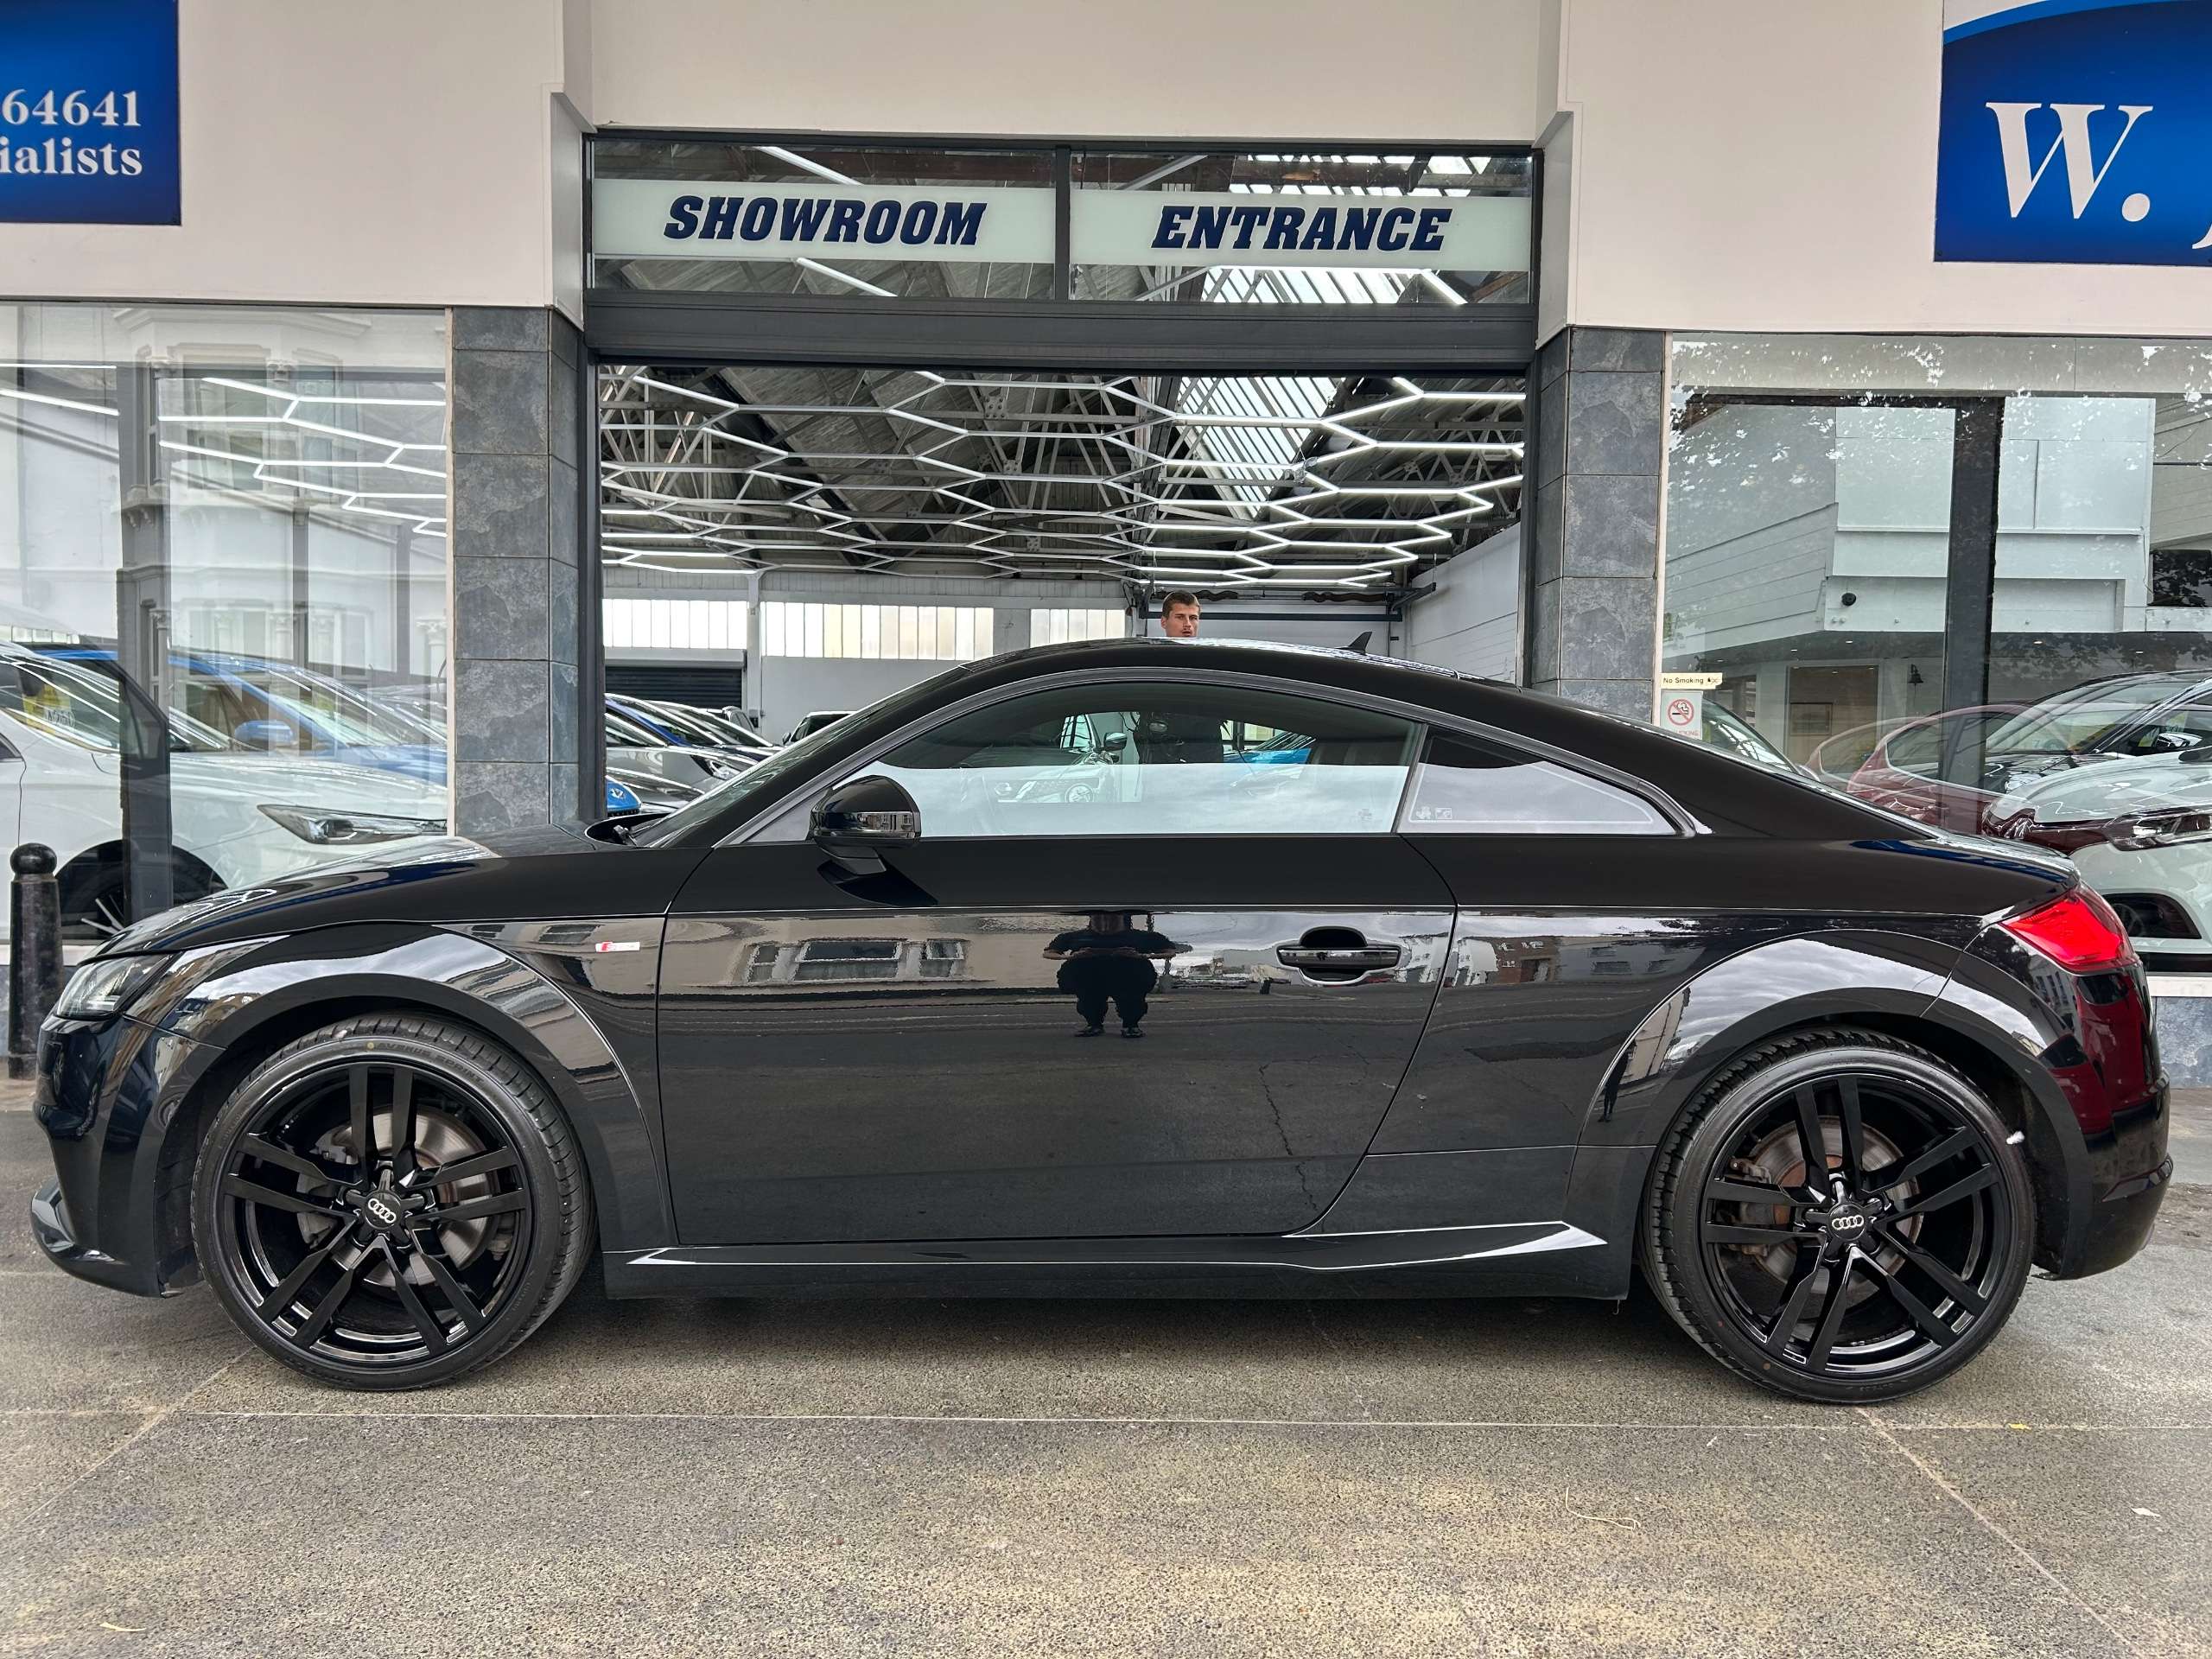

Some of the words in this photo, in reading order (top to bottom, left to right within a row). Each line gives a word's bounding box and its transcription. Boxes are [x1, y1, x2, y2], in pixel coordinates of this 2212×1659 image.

[2, 89, 142, 126] 64641
[0, 136, 143, 175] ialists
[1986, 102, 2153, 222] W.
[663, 194, 988, 246] SHOWROOM
[1151, 205, 1452, 251] ENTRANCE
